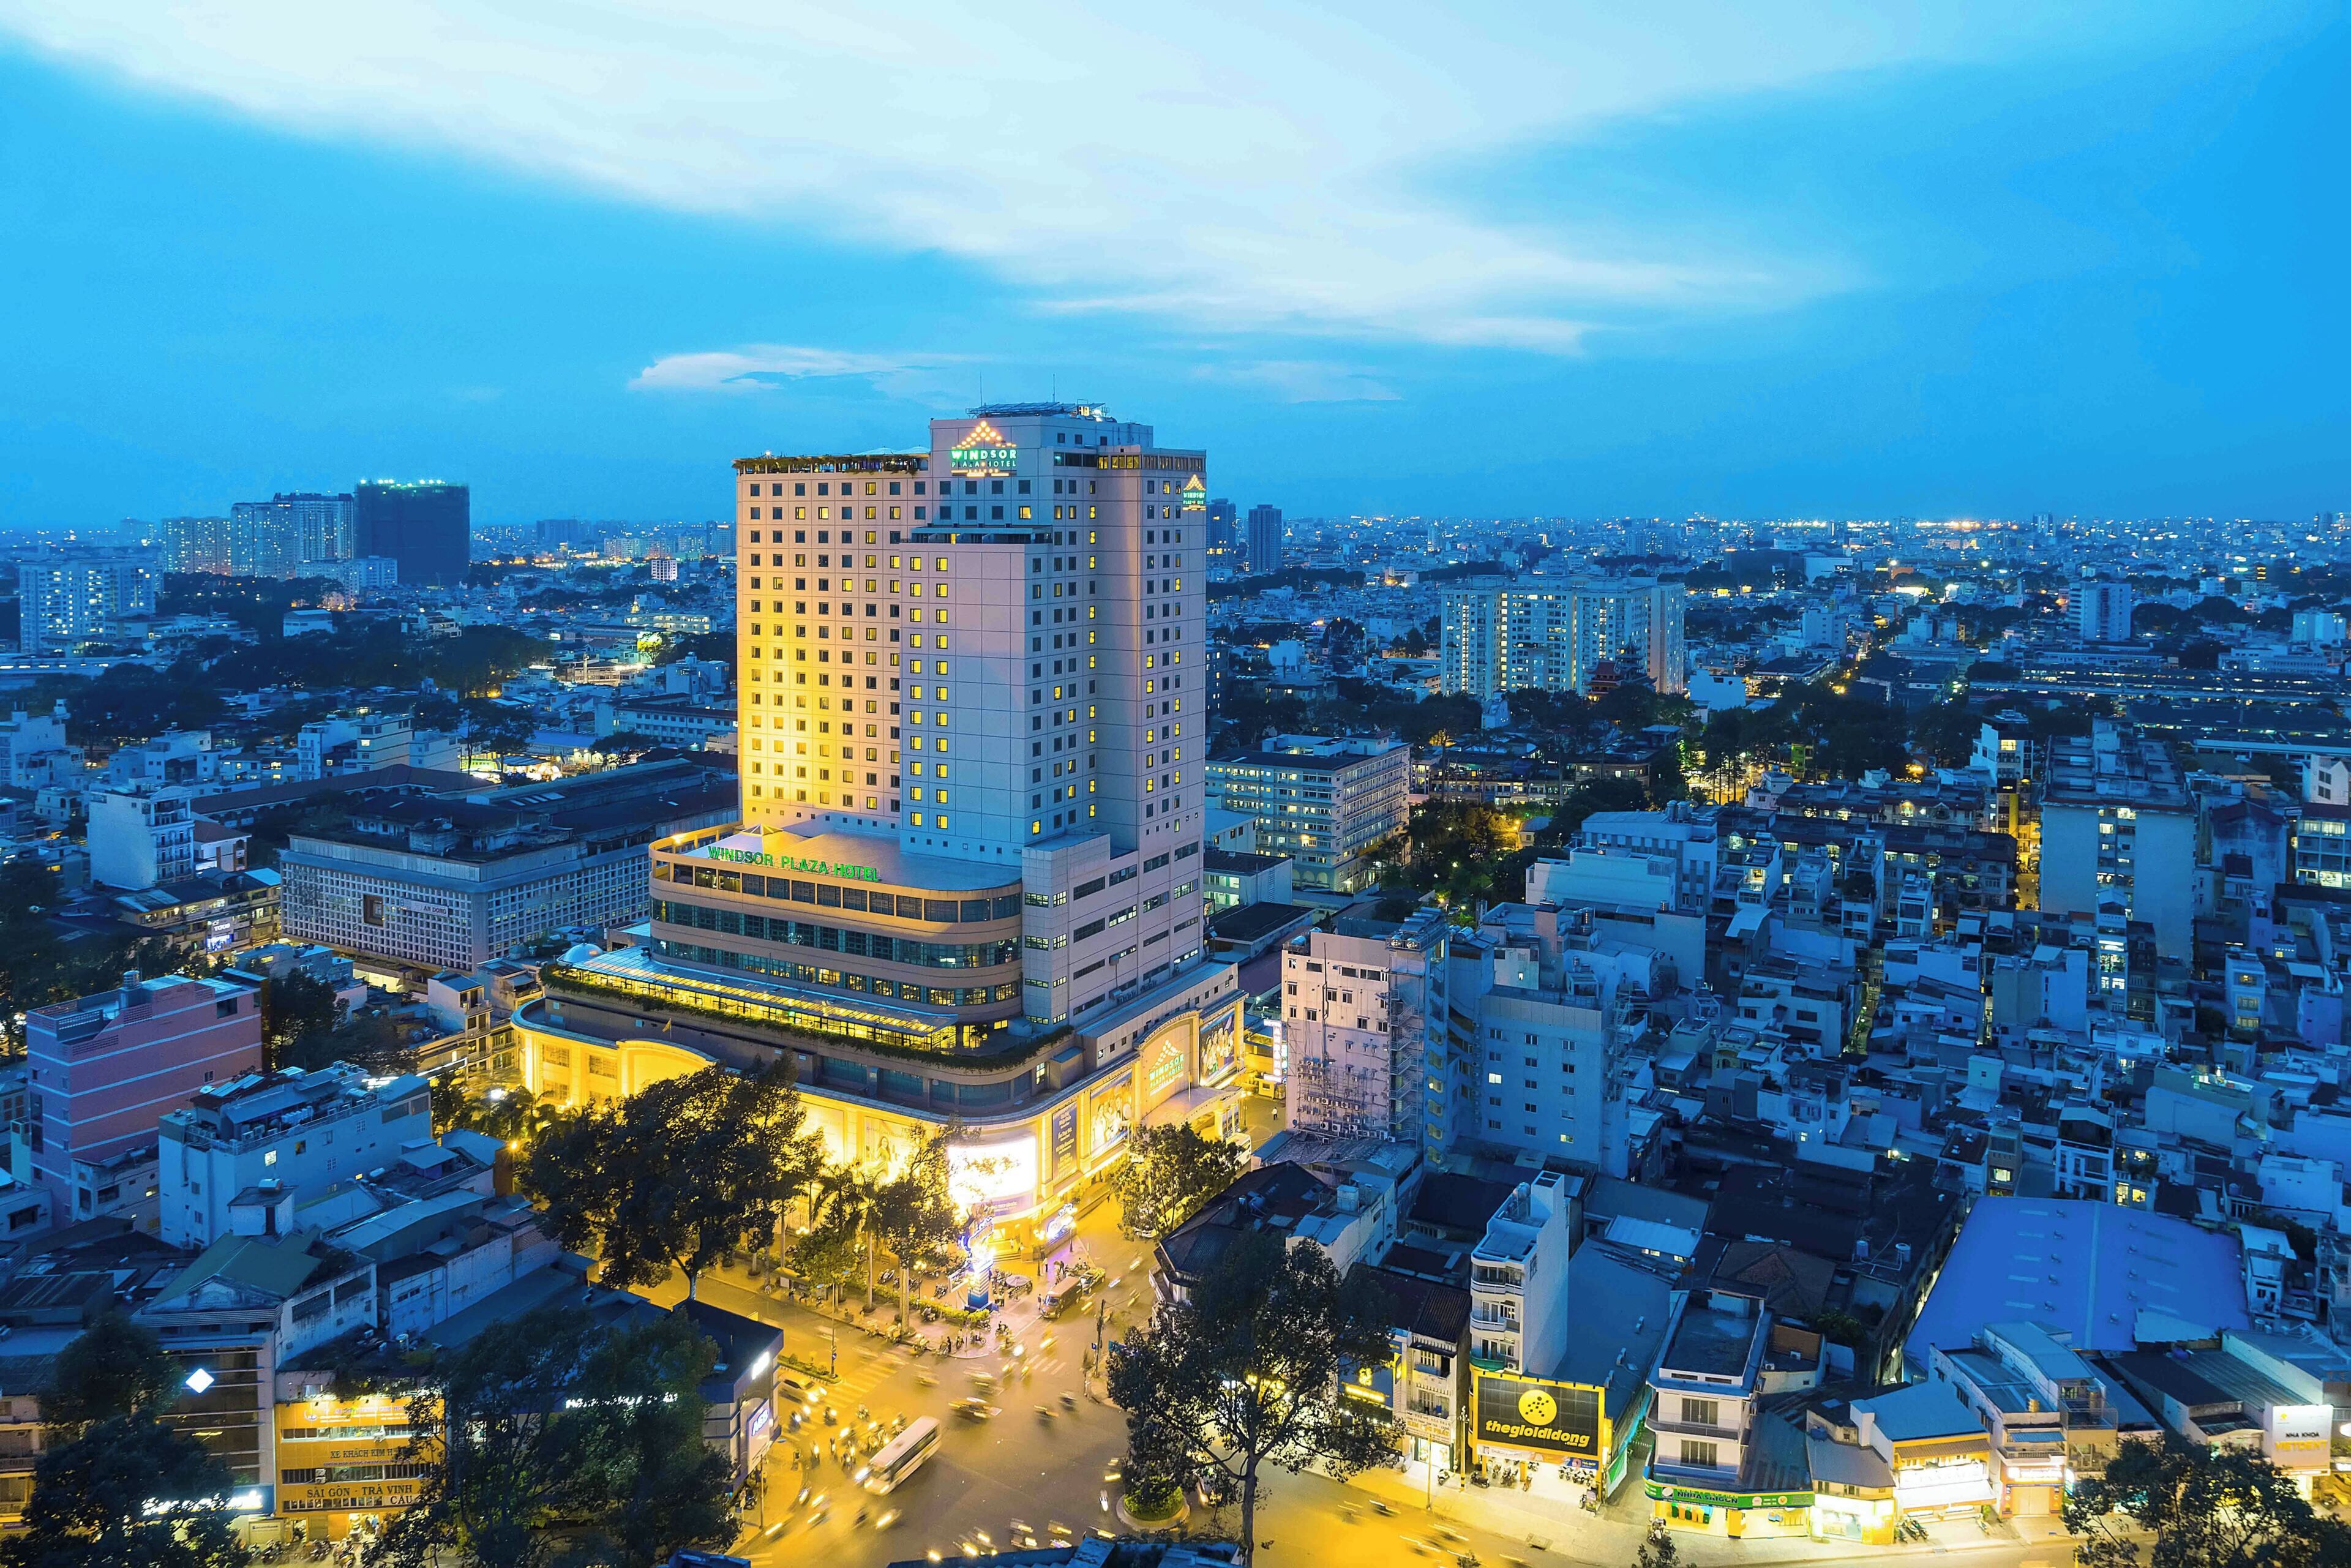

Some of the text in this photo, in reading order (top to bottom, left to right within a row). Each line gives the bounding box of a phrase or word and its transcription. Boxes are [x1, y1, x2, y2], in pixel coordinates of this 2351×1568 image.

[951, 449, 1017, 460] WINDSOR
[708, 846, 882, 882] WINDSOR PLAZA HOTEL
[1149, 1053, 1184, 1081] WINDSOR
[387, 1485, 413, 1494] VINH
